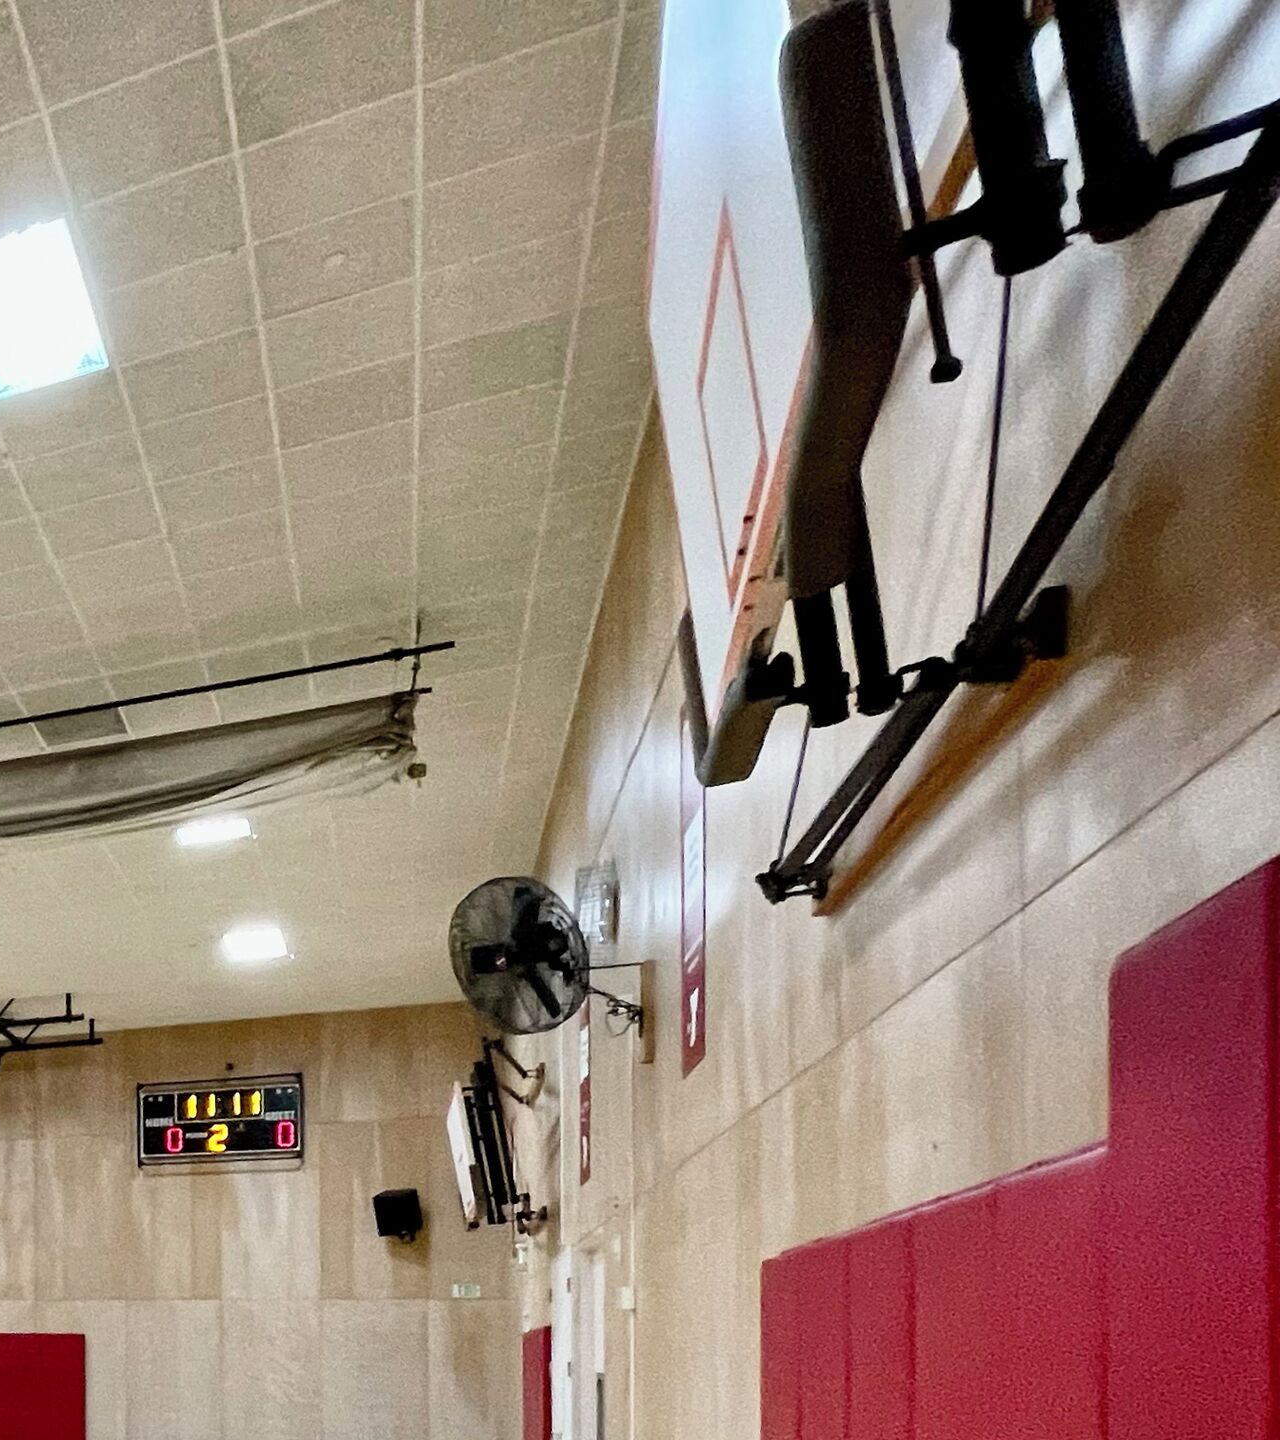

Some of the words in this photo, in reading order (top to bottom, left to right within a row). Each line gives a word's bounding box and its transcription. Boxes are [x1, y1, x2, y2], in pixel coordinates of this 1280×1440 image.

[166, 1127, 183, 1153] 0
[206, 1123, 229, 1152] 2
[276, 1121, 295, 1147] 0
